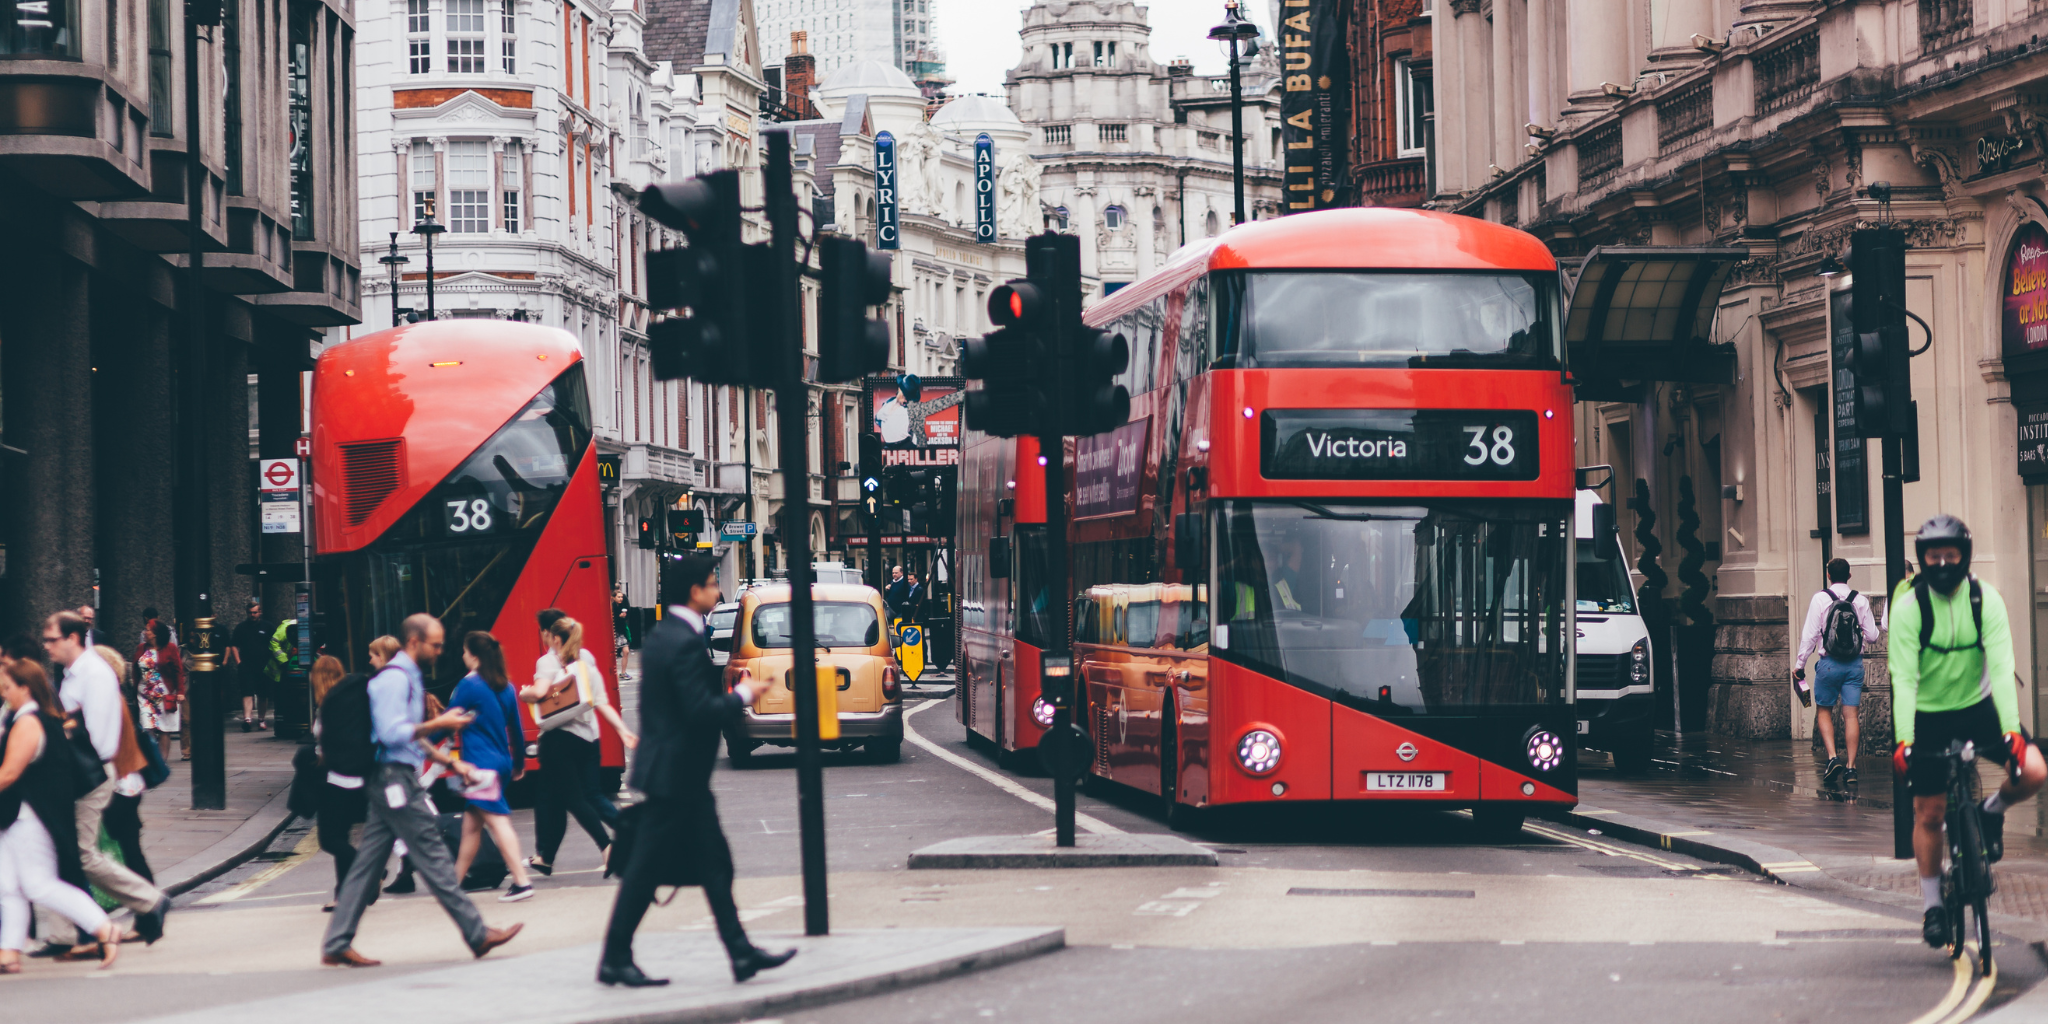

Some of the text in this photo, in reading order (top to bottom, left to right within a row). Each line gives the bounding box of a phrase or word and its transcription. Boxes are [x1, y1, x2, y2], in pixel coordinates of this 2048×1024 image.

[1287, 108, 1314, 150] LA
[877, 152, 895, 242] LYRIC
[977, 149, 992, 238] APOLLO
[2012, 265, 2047, 296] Believe
[2020, 303, 2030, 324] or
[2026, 324, 2048, 344] LONDON
[296, 440, 310, 455] H
[927, 436, 958, 444] JACKSON 5
[1306, 425, 1515, 465] Victoria 38
[2024, 450, 2036, 461] BARS
[1822, 481, 1831, 493] BAR
[447, 499, 490, 532] 38
[1378, 774, 1433, 787] LTZ 1178
